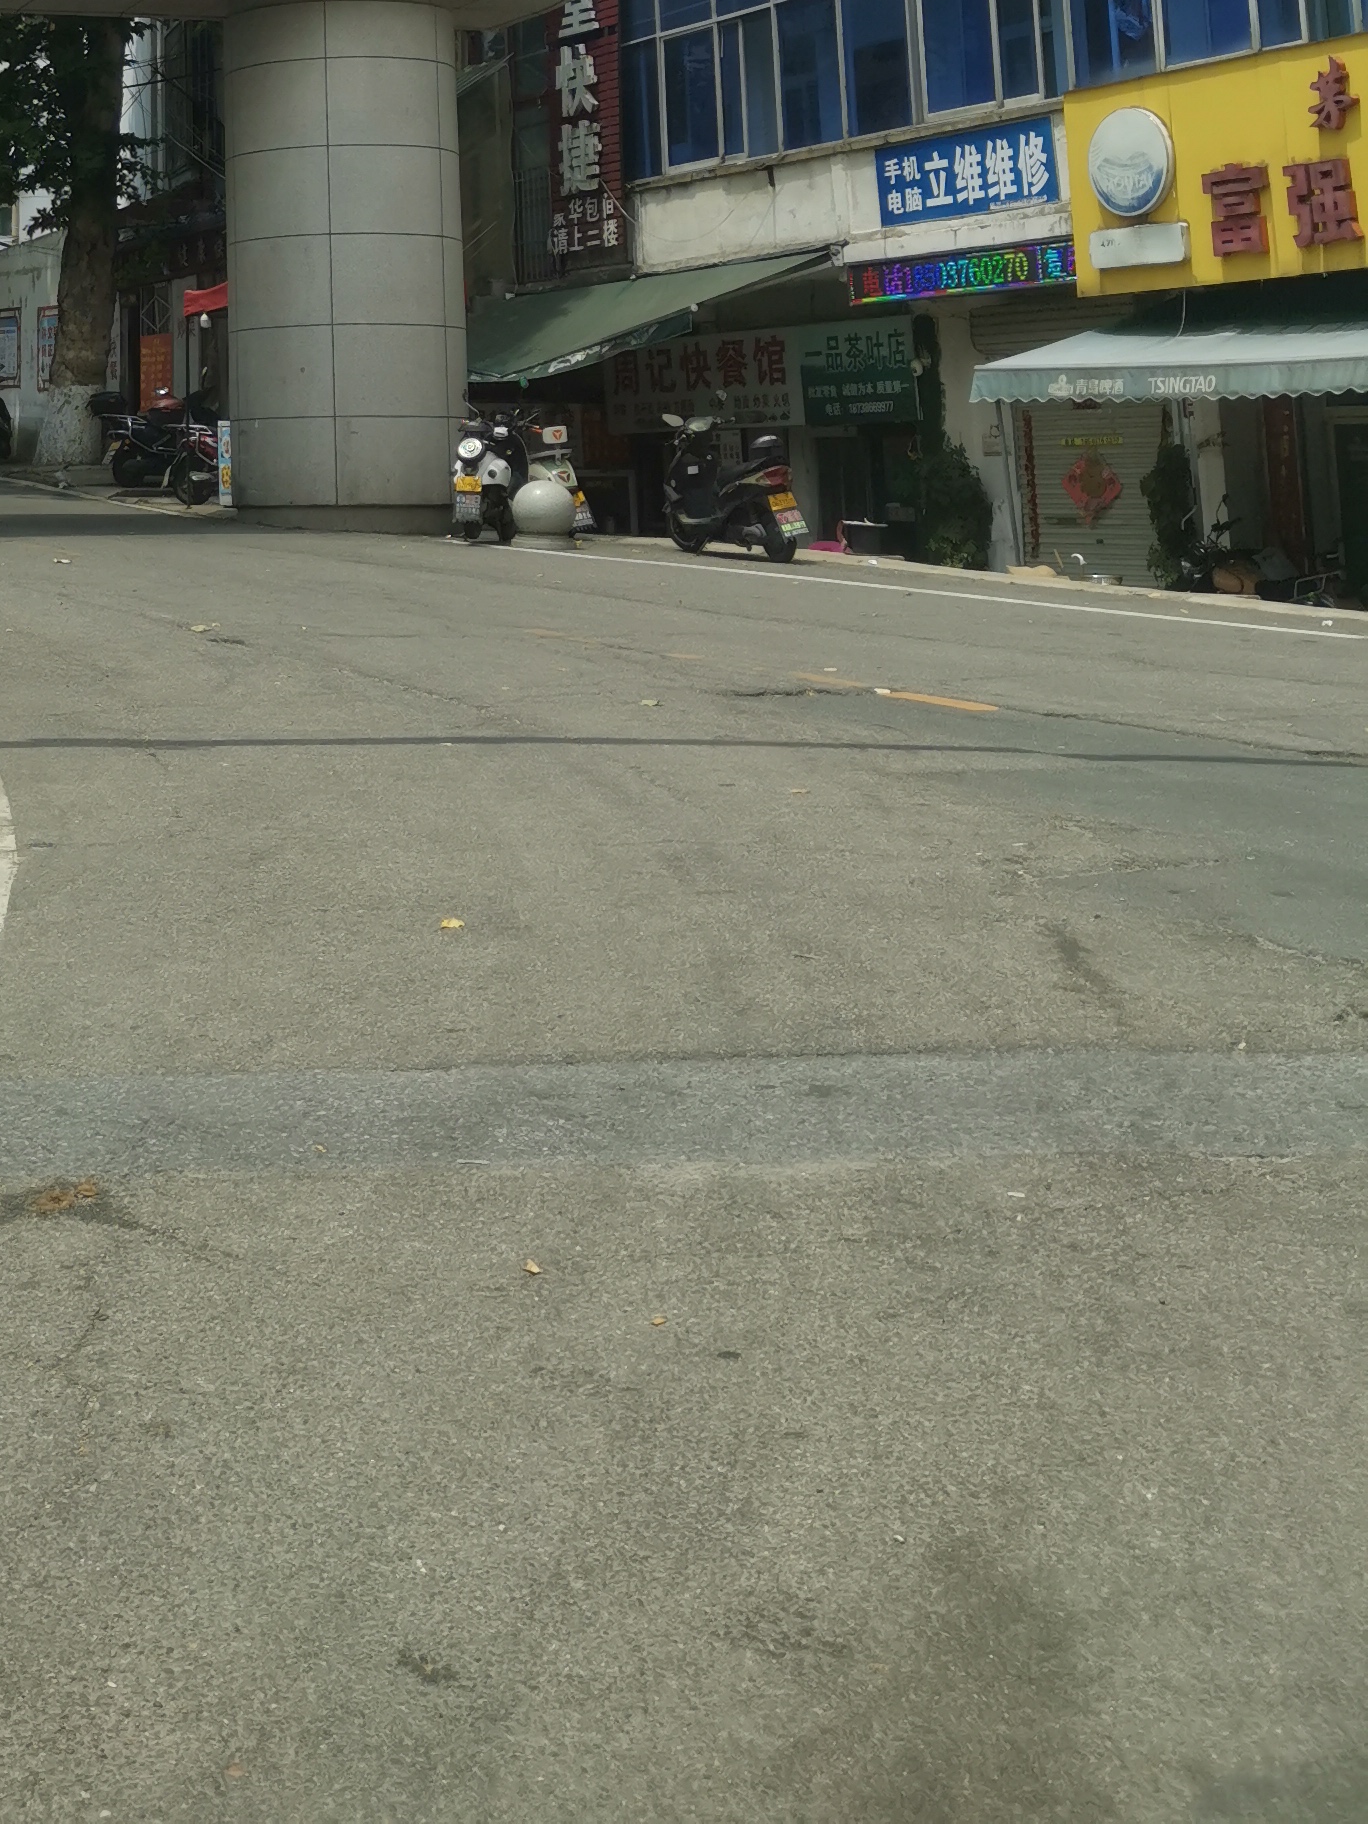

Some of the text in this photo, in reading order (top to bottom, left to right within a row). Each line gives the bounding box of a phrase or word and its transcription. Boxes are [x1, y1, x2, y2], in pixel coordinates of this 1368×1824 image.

[884, 155, 922, 185] 手机
[923, 131, 1050, 208] 立维维修
[887, 186, 924, 215] 电脑
[1201, 159, 1365, 258] 富强
[804, 328, 907, 372] 一品茶叶店
[1075, 378, 1124, 396] 青岛啤酒
[1147, 374, 1216, 396] TSINGTAO
